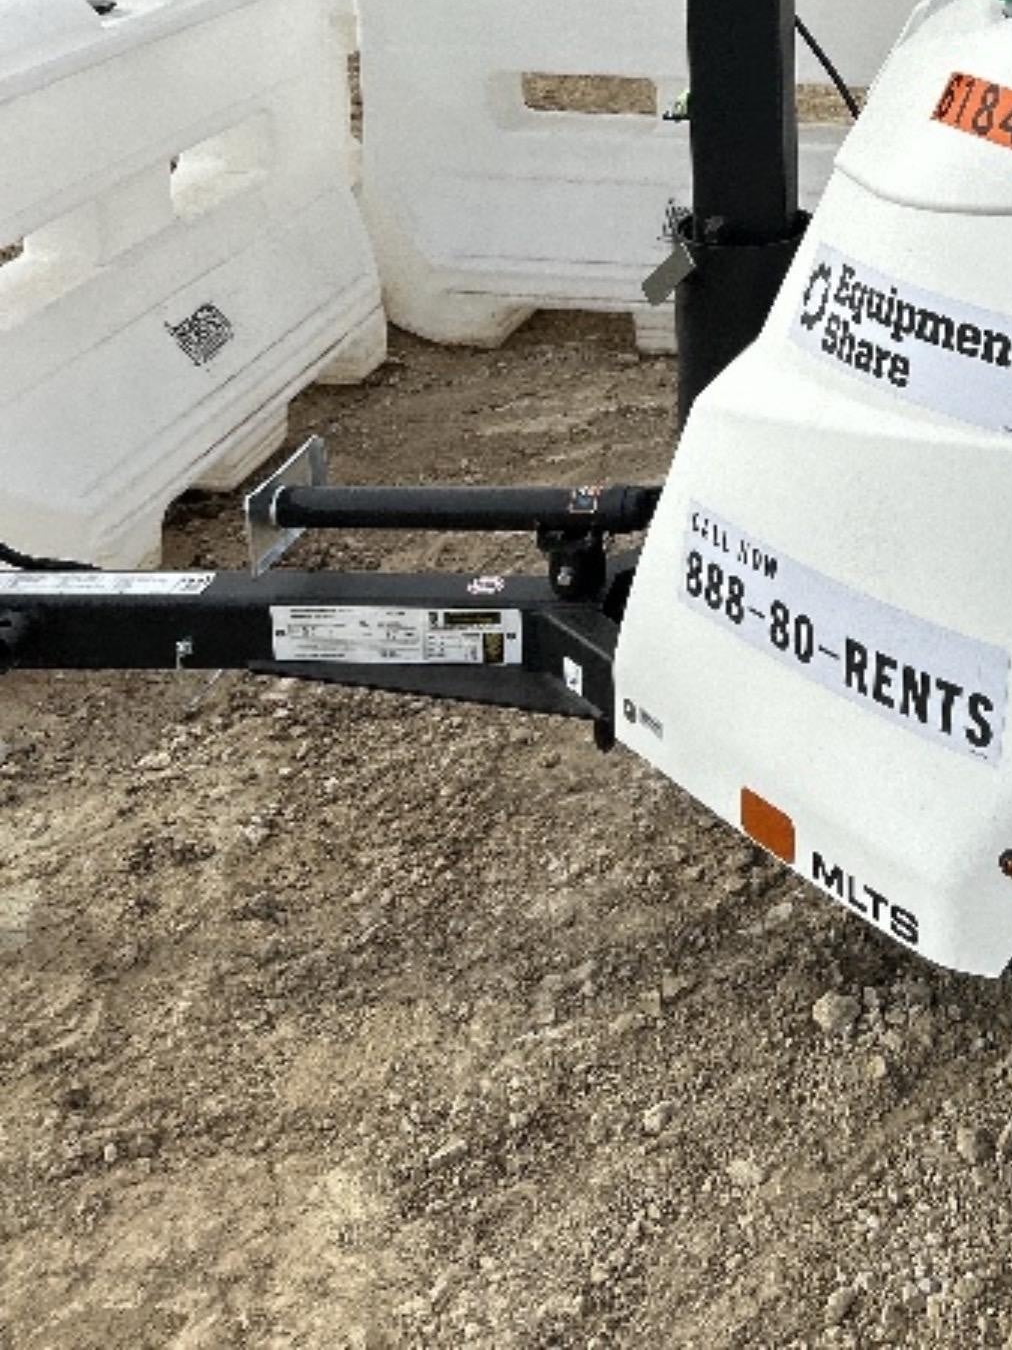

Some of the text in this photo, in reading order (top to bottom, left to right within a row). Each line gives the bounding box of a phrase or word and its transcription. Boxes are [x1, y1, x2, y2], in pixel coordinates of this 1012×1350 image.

[821, 312, 910, 388] Share
[686, 550, 994, 748] 888-80-RENTS
[812, 851, 920, 945] MLTS
